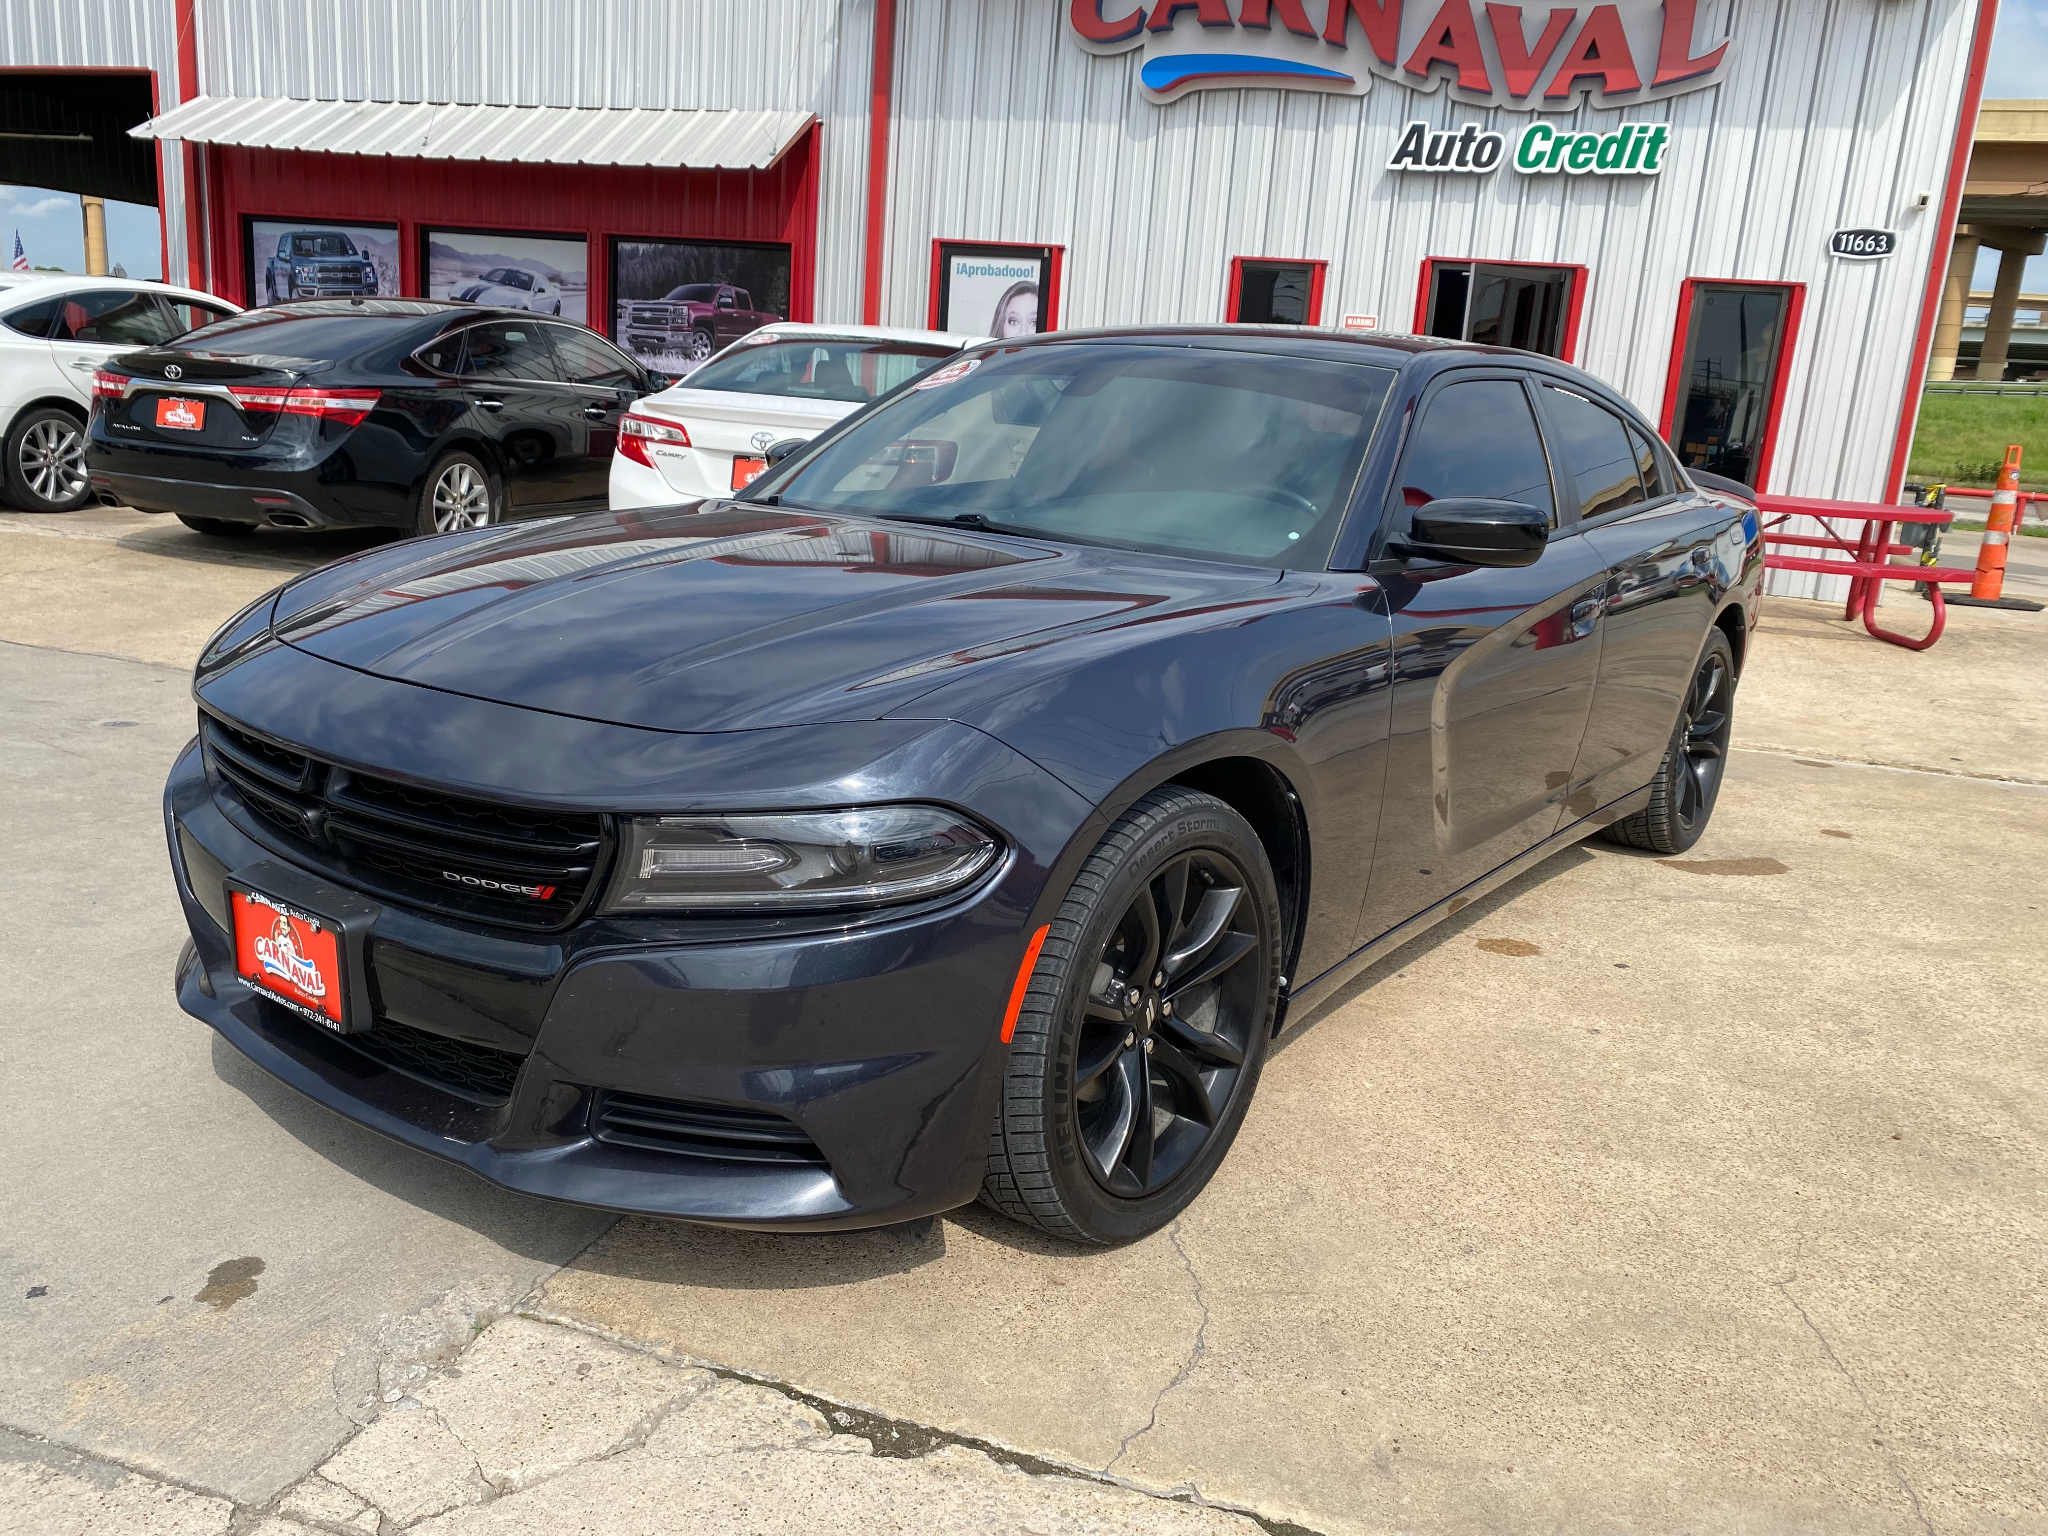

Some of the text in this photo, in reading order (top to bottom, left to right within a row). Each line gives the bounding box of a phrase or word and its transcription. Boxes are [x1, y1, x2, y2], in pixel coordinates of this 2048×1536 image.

[1390, 124, 1668, 169] Auto Credit
[1840, 233, 1887, 252] 11663
[956, 262, 1034, 278] ¡Aprobadooo!
[1347, 317, 1374, 327] WARNING
[1127, 829, 1176, 877] Desert
[1177, 818, 1217, 837] Storm
[442, 870, 541, 896] DODGE
[251, 891, 289, 916] CARNAVAL
[254, 938, 324, 991] CARNAVAL
[303, 1007, 340, 1032] 972-241-8141
